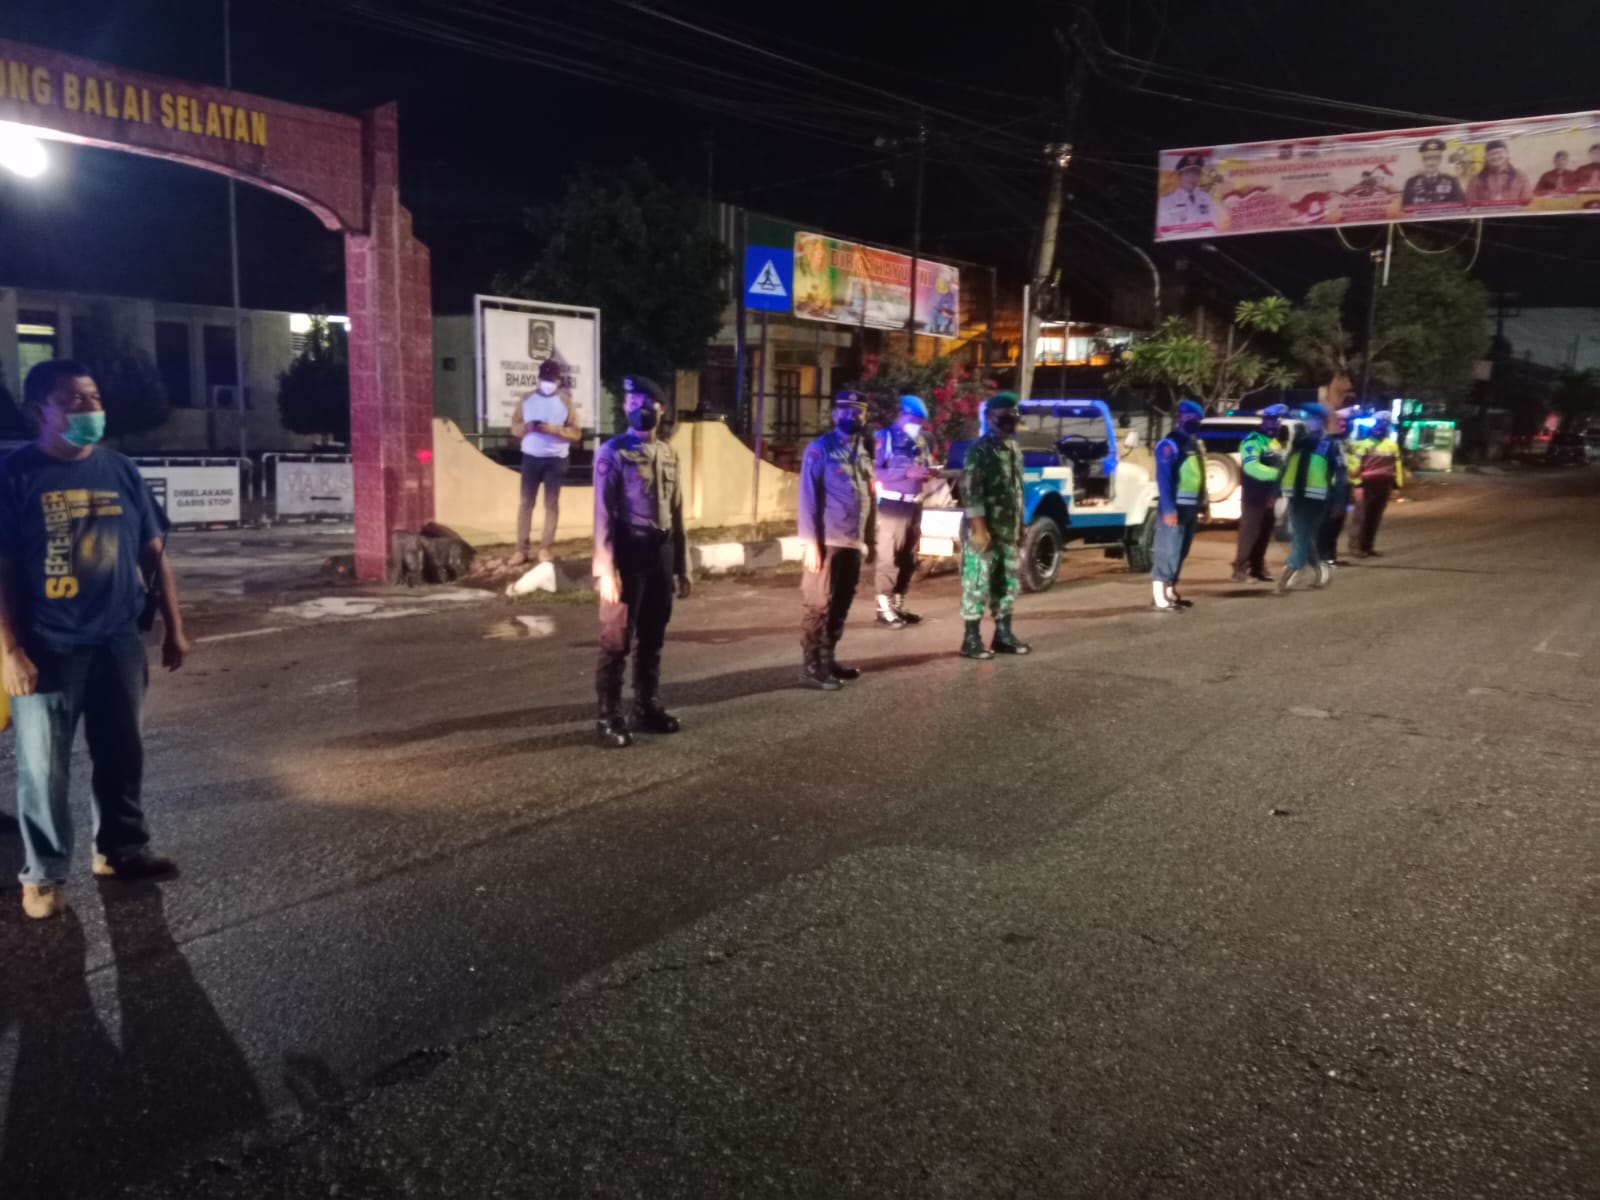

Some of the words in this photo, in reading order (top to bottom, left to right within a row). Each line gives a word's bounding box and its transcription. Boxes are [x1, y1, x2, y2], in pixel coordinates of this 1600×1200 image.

[63, 72, 150, 124] BALAI
[160, 92, 267, 147] SELATAN
[173, 488, 234, 498] DIBELAKANG
[176, 499, 205, 507] GARIS
[207, 498, 232, 506] STOP
[41, 490, 79, 599] SEPTEMBER
